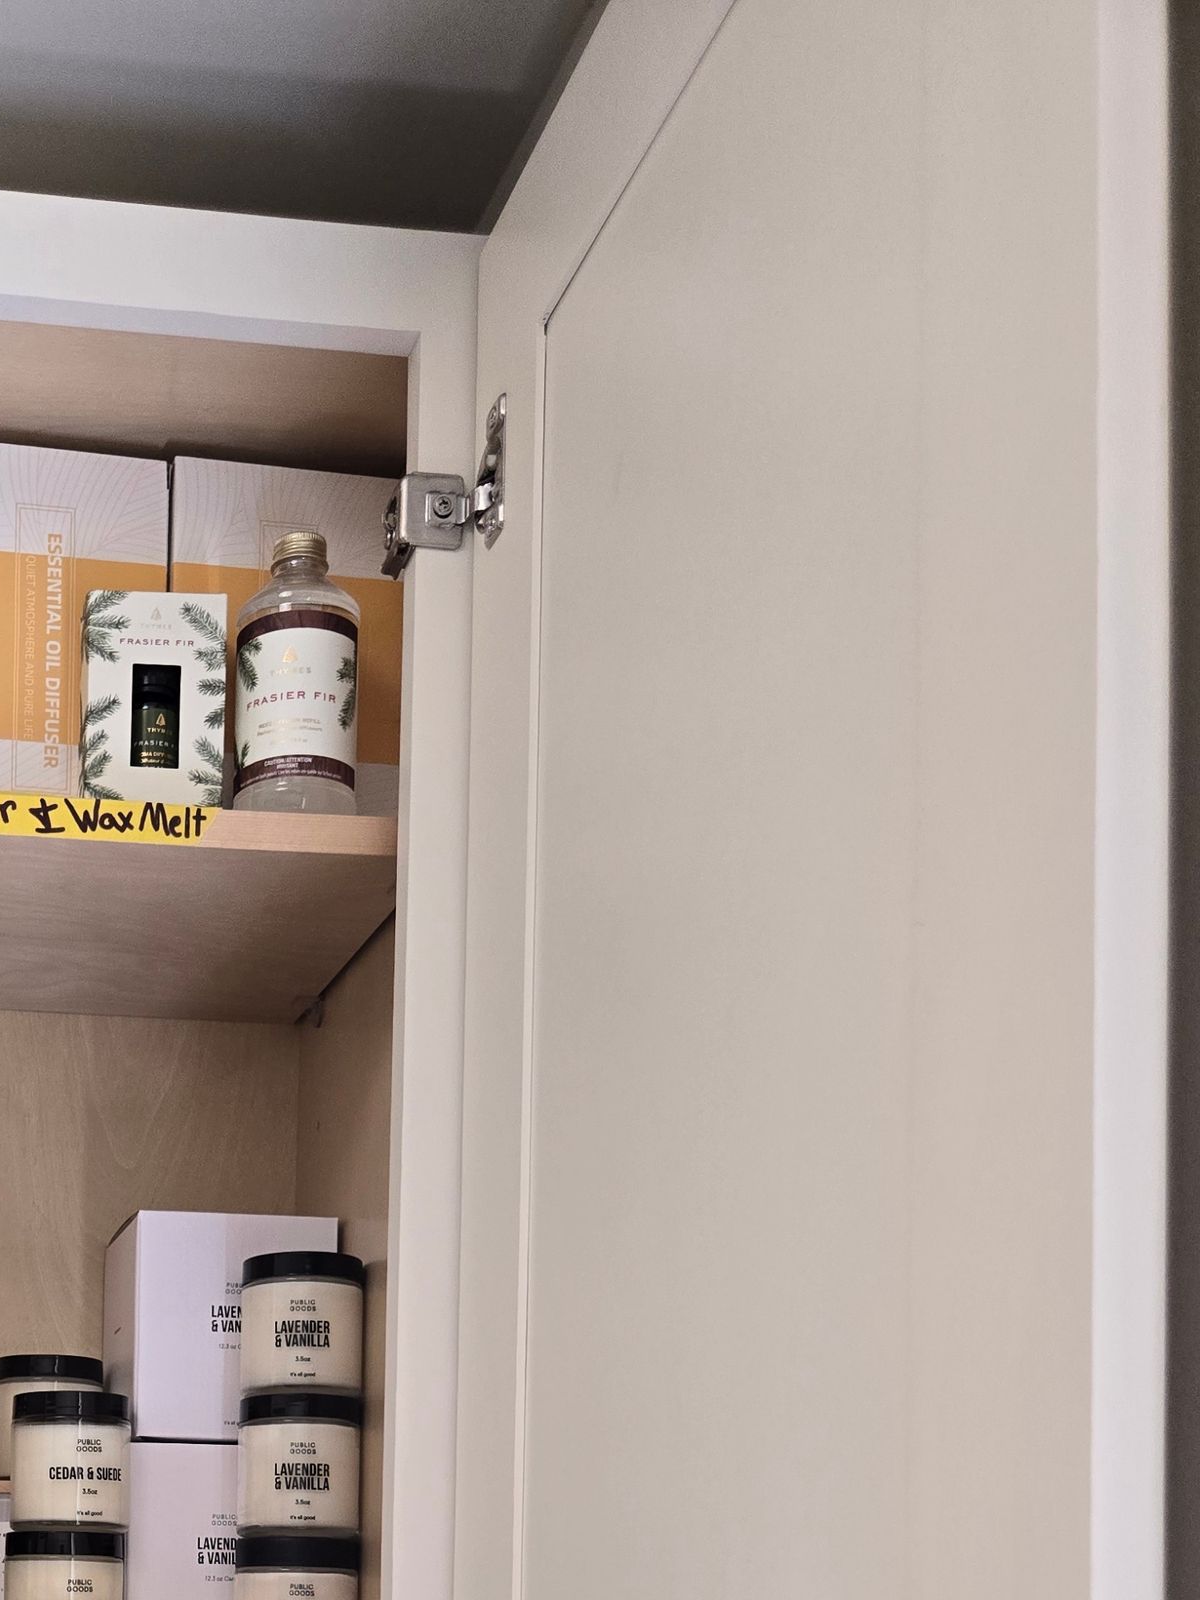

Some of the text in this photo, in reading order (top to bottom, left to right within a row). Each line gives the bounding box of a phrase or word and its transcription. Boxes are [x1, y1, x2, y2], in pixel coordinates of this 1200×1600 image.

[23, 556, 36, 739] QUIET ATMOSPHERE AND PURE LIFE
[120, 638, 194, 647] FRASIER FIR
[43, 533, 63, 768] ESSENTIAL OIL DIFFUSER
[246, 690, 337, 711] FRASIER FIR
[63, 797, 136, 833] Wax
[138, 801, 208, 839] Melt
[211, 1320, 218, 1332] &
[275, 1320, 330, 1334] LAVENDER
[275, 1334, 330, 1347] & VANILLA
[49, 1467, 122, 1481] CEDAR & SUEDE
[275, 1463, 329, 1477] LAVENDER
[275, 1477, 329, 1491] & VANILLA
[198, 1552, 204, 1564] &
